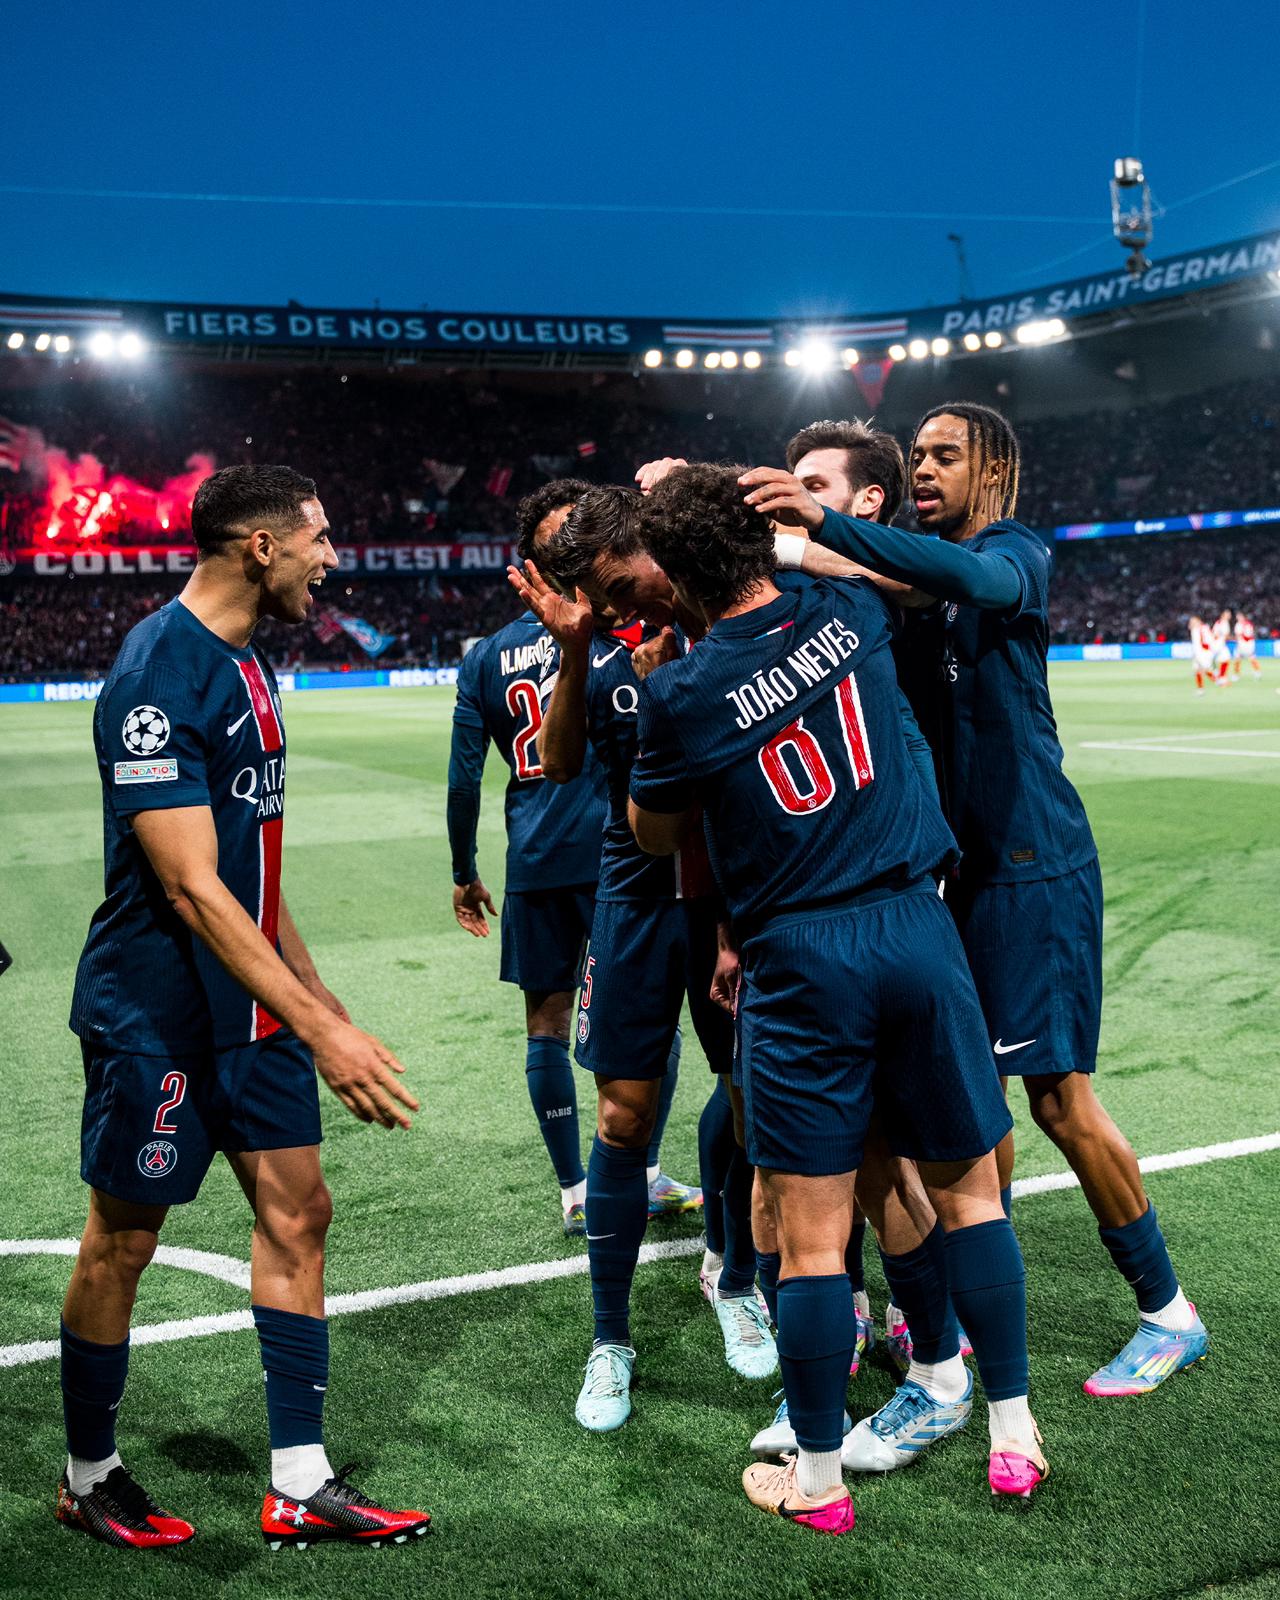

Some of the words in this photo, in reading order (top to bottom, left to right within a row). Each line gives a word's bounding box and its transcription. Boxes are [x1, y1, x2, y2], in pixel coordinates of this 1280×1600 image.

[164, 310, 277, 337] FIERS
[288, 314, 339, 339] DE
[350, 316, 428, 341] NOS
[437, 317, 631, 346] COULEURS
[943, 297, 1036, 335] PARIS
[365, 544, 451, 572] C'EST
[461, 544, 504, 570] AU
[725, 669, 798, 730] JOÃO
[786, 617, 860, 688] NEVES
[116, 765, 176, 777] FOUNDATION
[152, 1070, 187, 1135] 2
[546, 1106, 572, 1120] PARIS
[146, 1142, 173, 1152] PARIS
